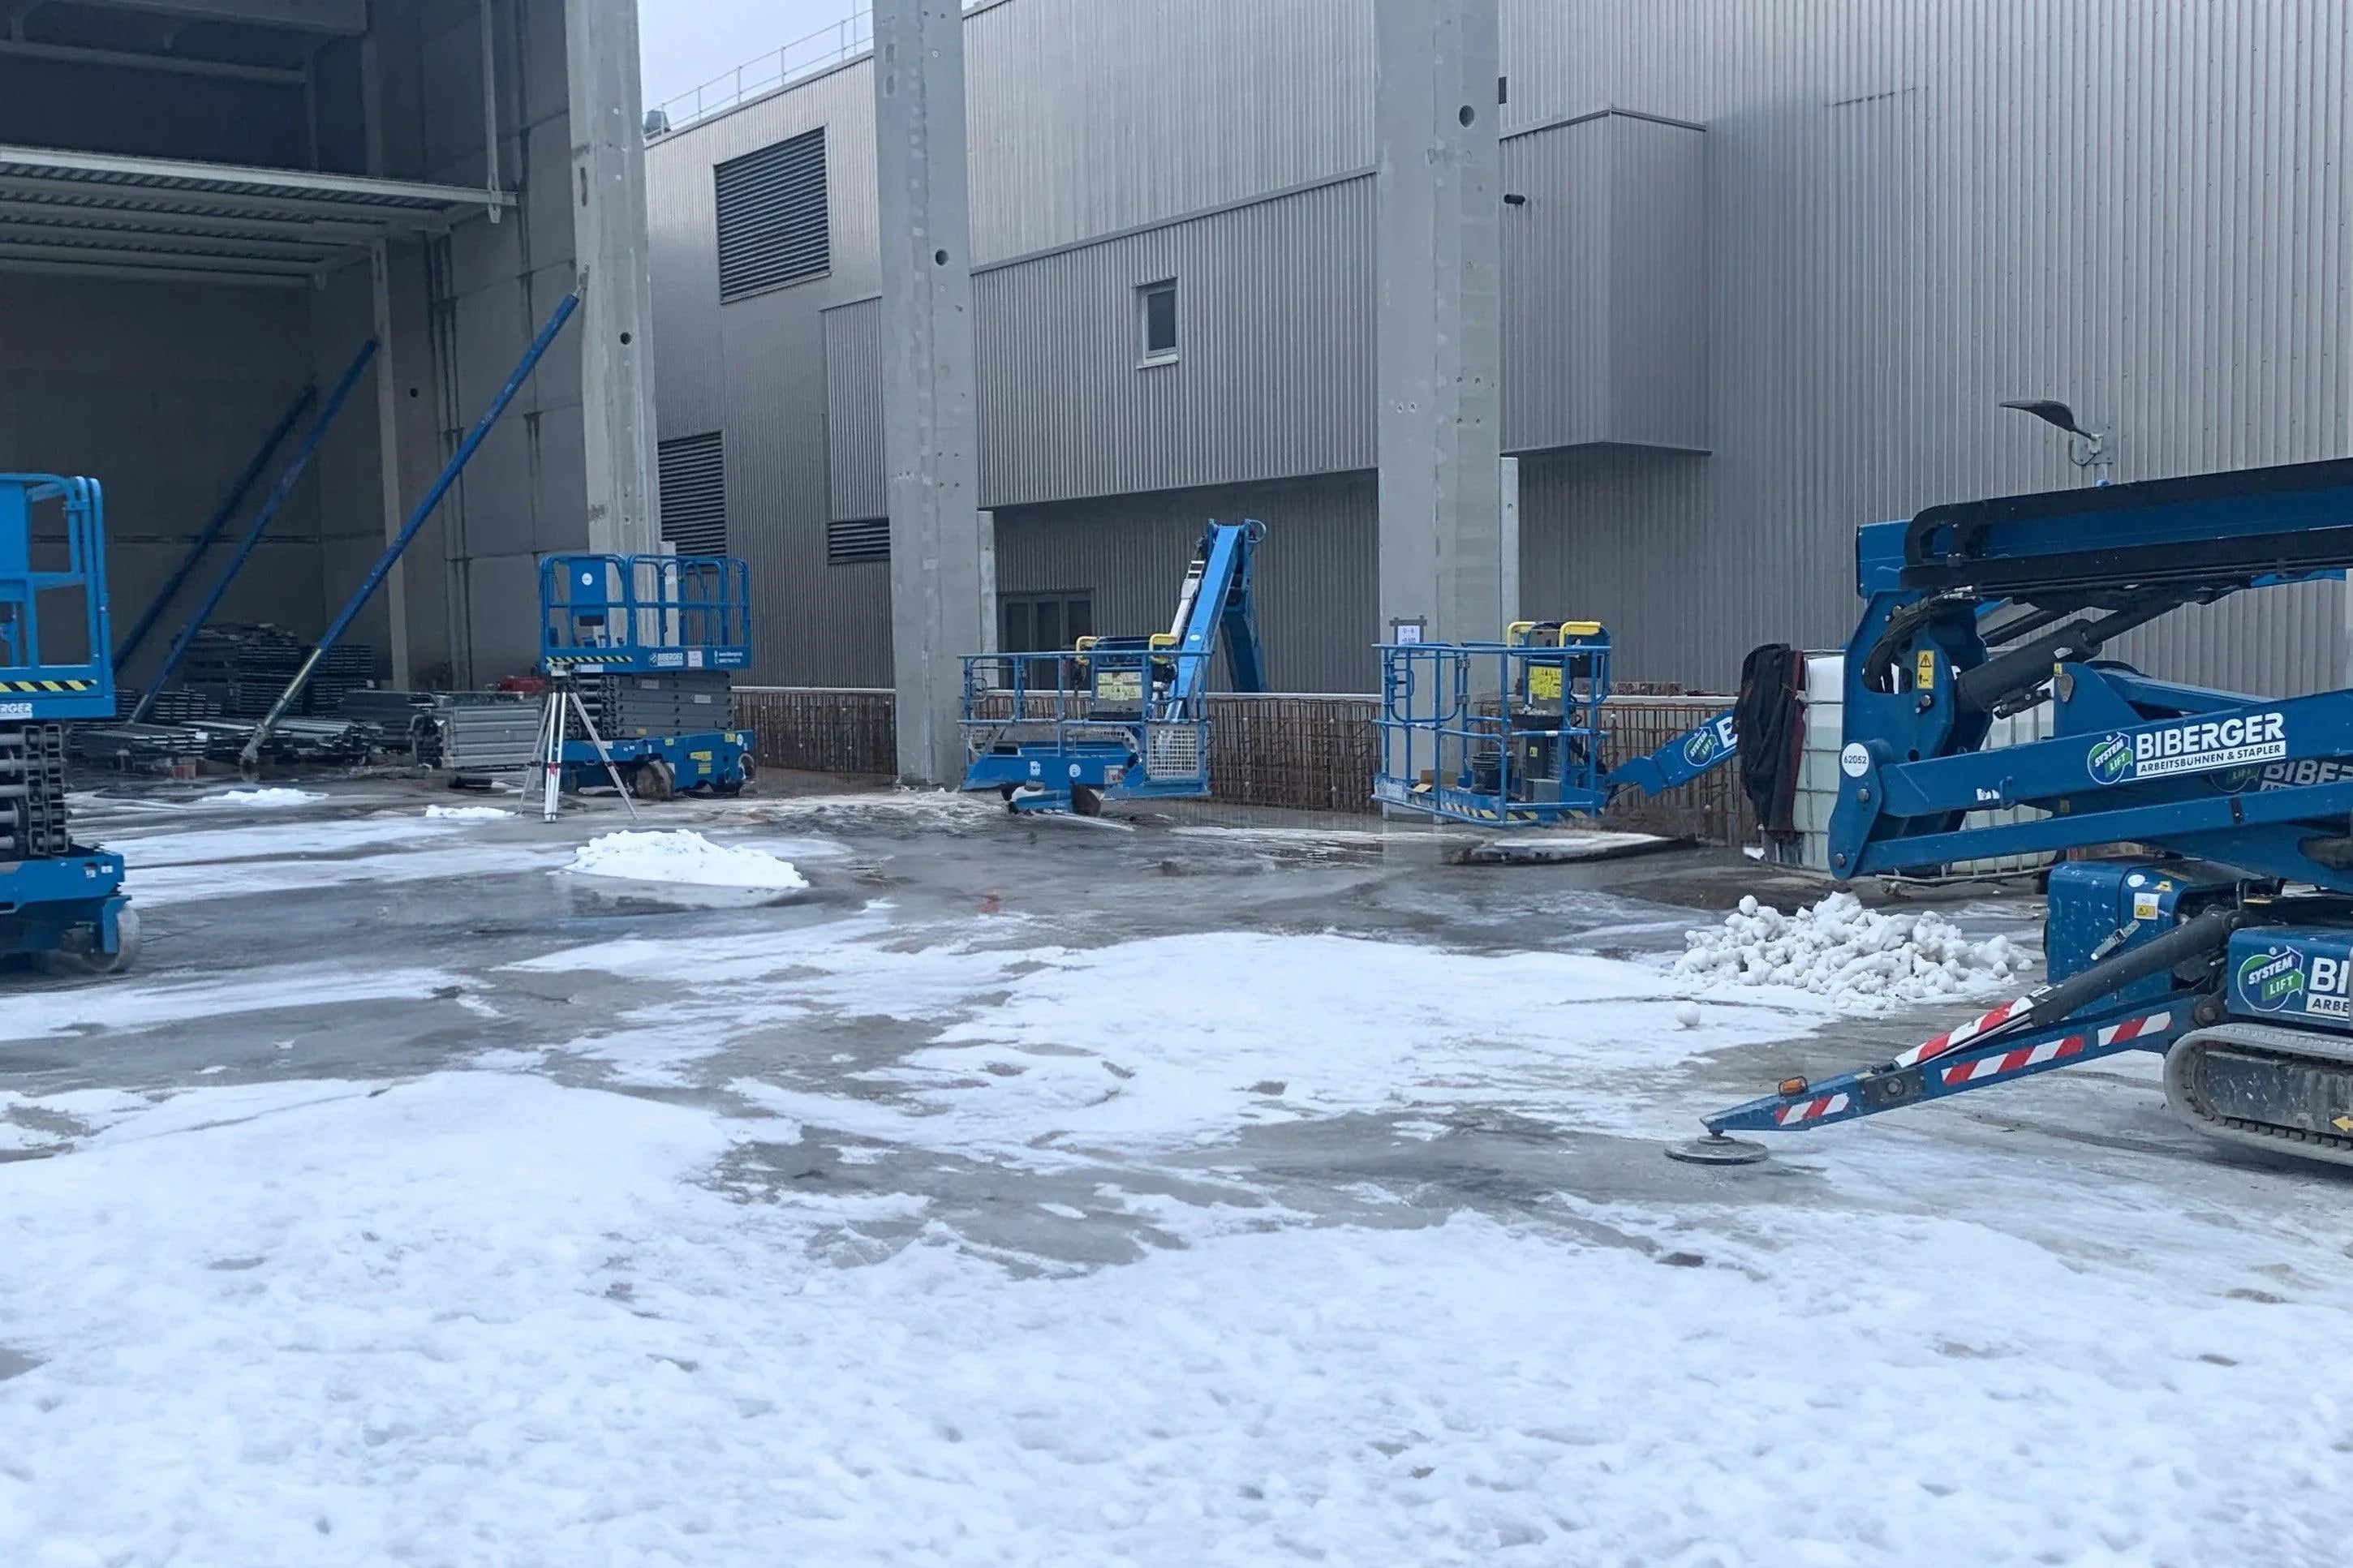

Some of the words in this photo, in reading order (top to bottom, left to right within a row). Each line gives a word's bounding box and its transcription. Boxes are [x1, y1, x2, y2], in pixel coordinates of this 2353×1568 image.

[0, 702, 32, 714] RGER
[1690, 730, 1708, 758] SYSTEM
[2136, 712, 2286, 760] BIBERGER
[1701, 738, 1713, 755] LIFT
[2094, 738, 2124, 768] SYSTEM
[2226, 751, 2235, 761] &
[2237, 744, 2282, 759] STAPLER
[1843, 755, 1867, 764] 62052
[2110, 753, 2126, 771] LIFT
[2248, 956, 2293, 985] SYSTEM
[2309, 957, 2350, 994] BI
[2269, 976, 2294, 995] LIFT
[2312, 999, 2350, 1012] ARBE
